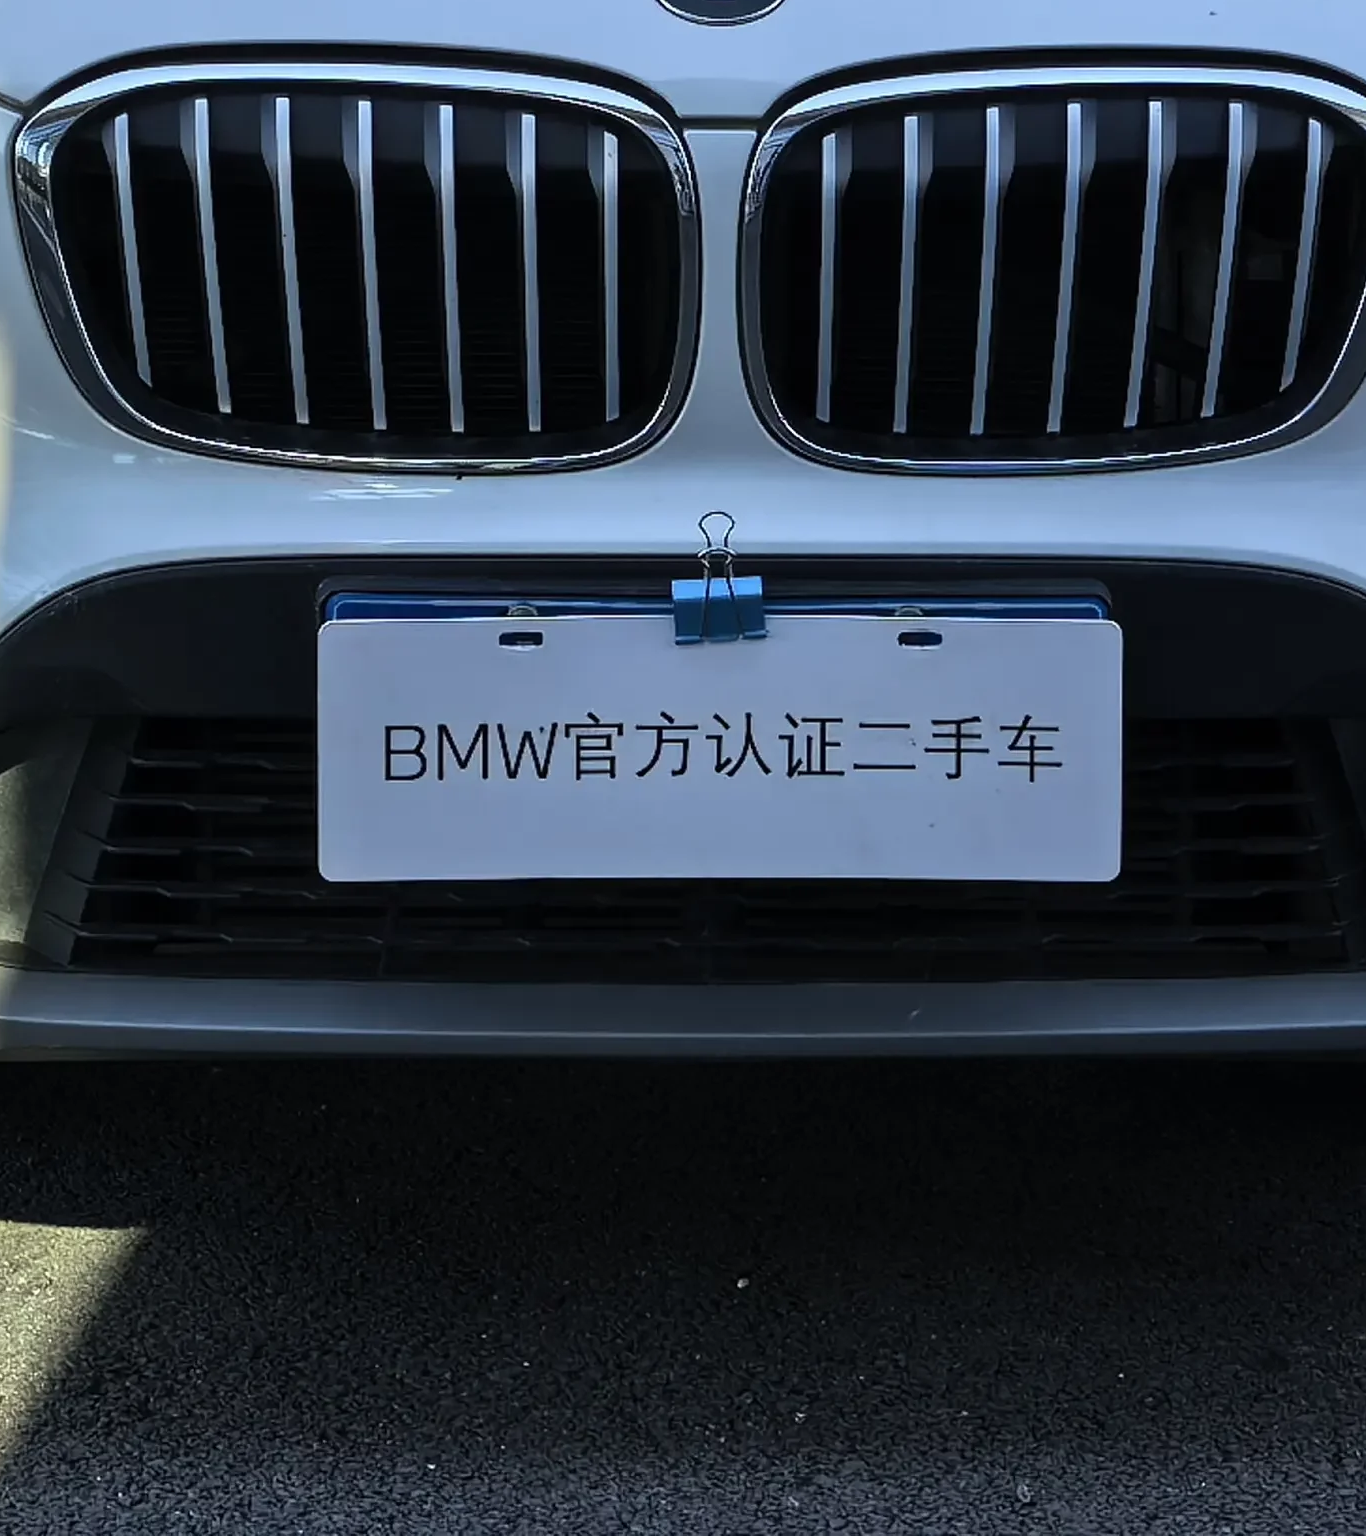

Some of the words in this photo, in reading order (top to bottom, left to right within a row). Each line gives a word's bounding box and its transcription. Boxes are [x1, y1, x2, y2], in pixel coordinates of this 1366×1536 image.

[383, 711, 1064, 783] BMW官方认证二手车
